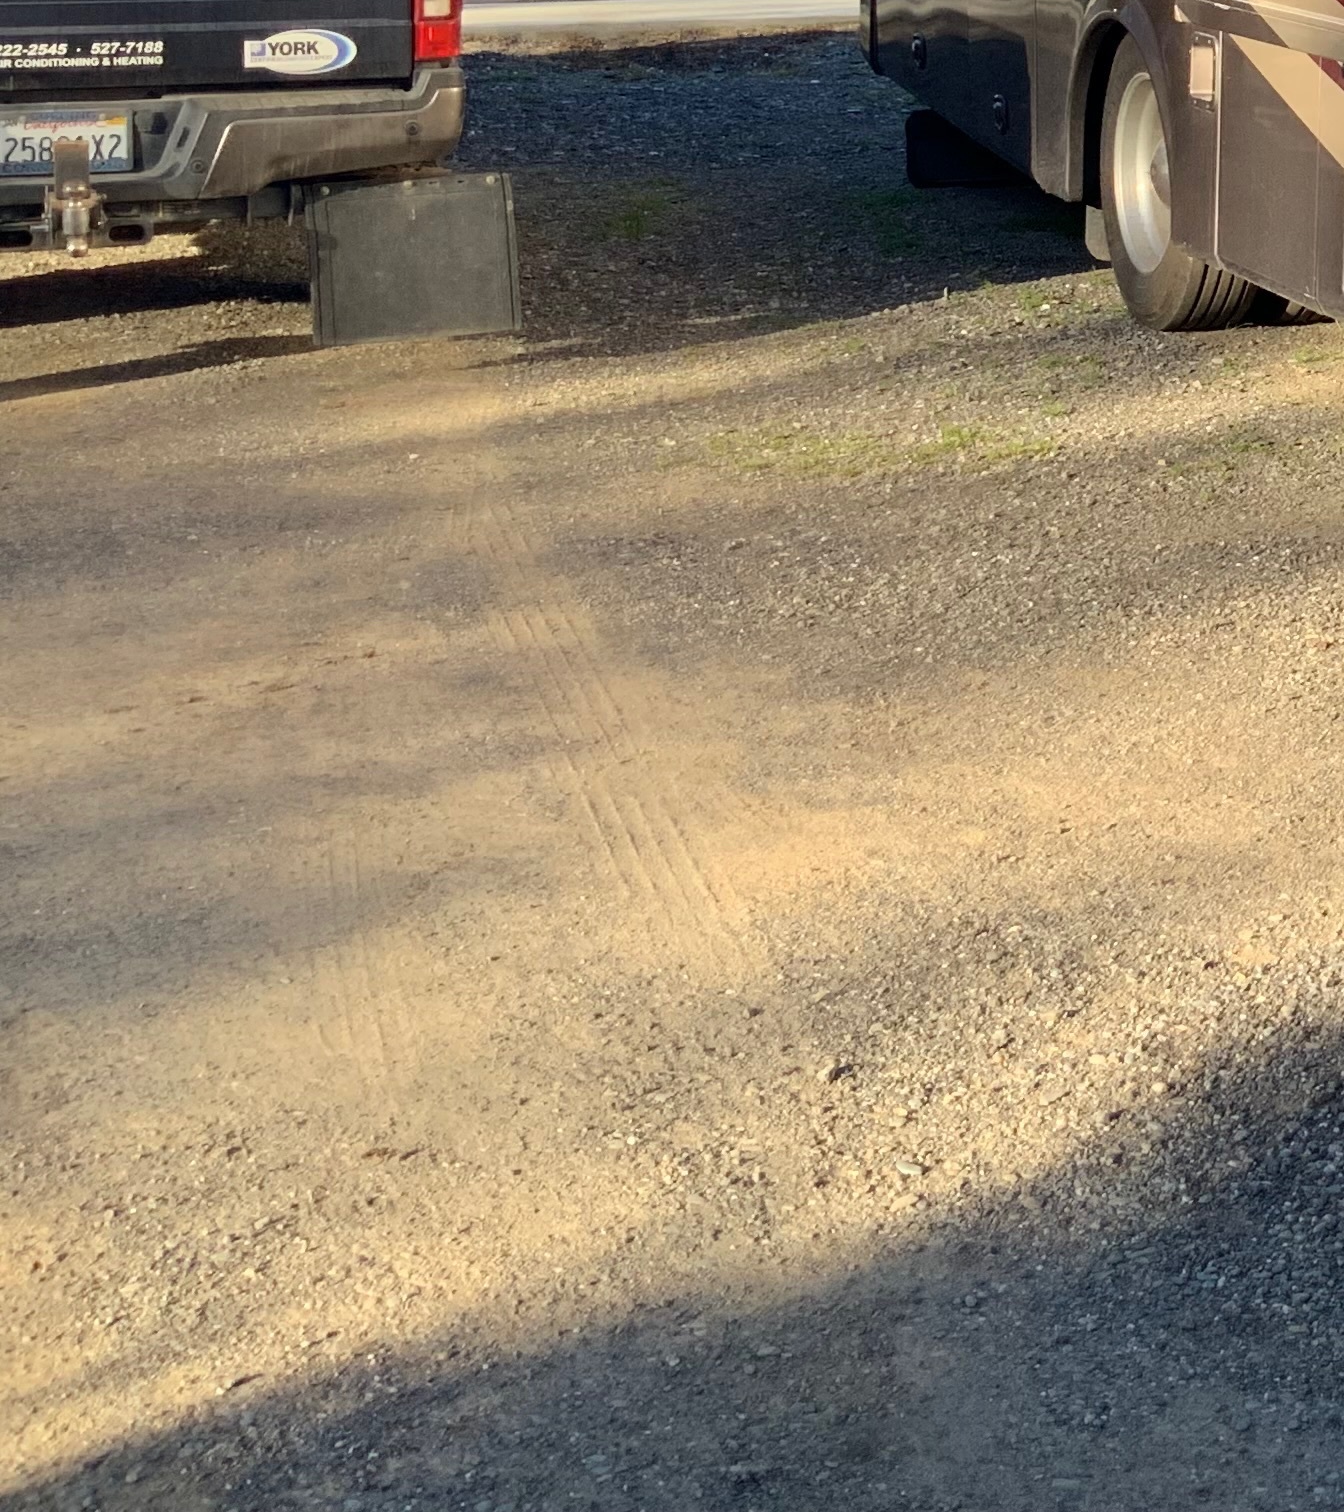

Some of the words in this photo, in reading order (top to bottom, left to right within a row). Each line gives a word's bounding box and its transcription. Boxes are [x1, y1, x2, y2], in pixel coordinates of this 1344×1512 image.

[90, 40, 164, 55] 527-7188
[267, 40, 320, 56] YORK
[14, 56, 99, 68] CONDITIONING
[101, 56, 111, 66] &
[113, 55, 164, 66] HEATING
[4, 133, 121, 163] 258X2
